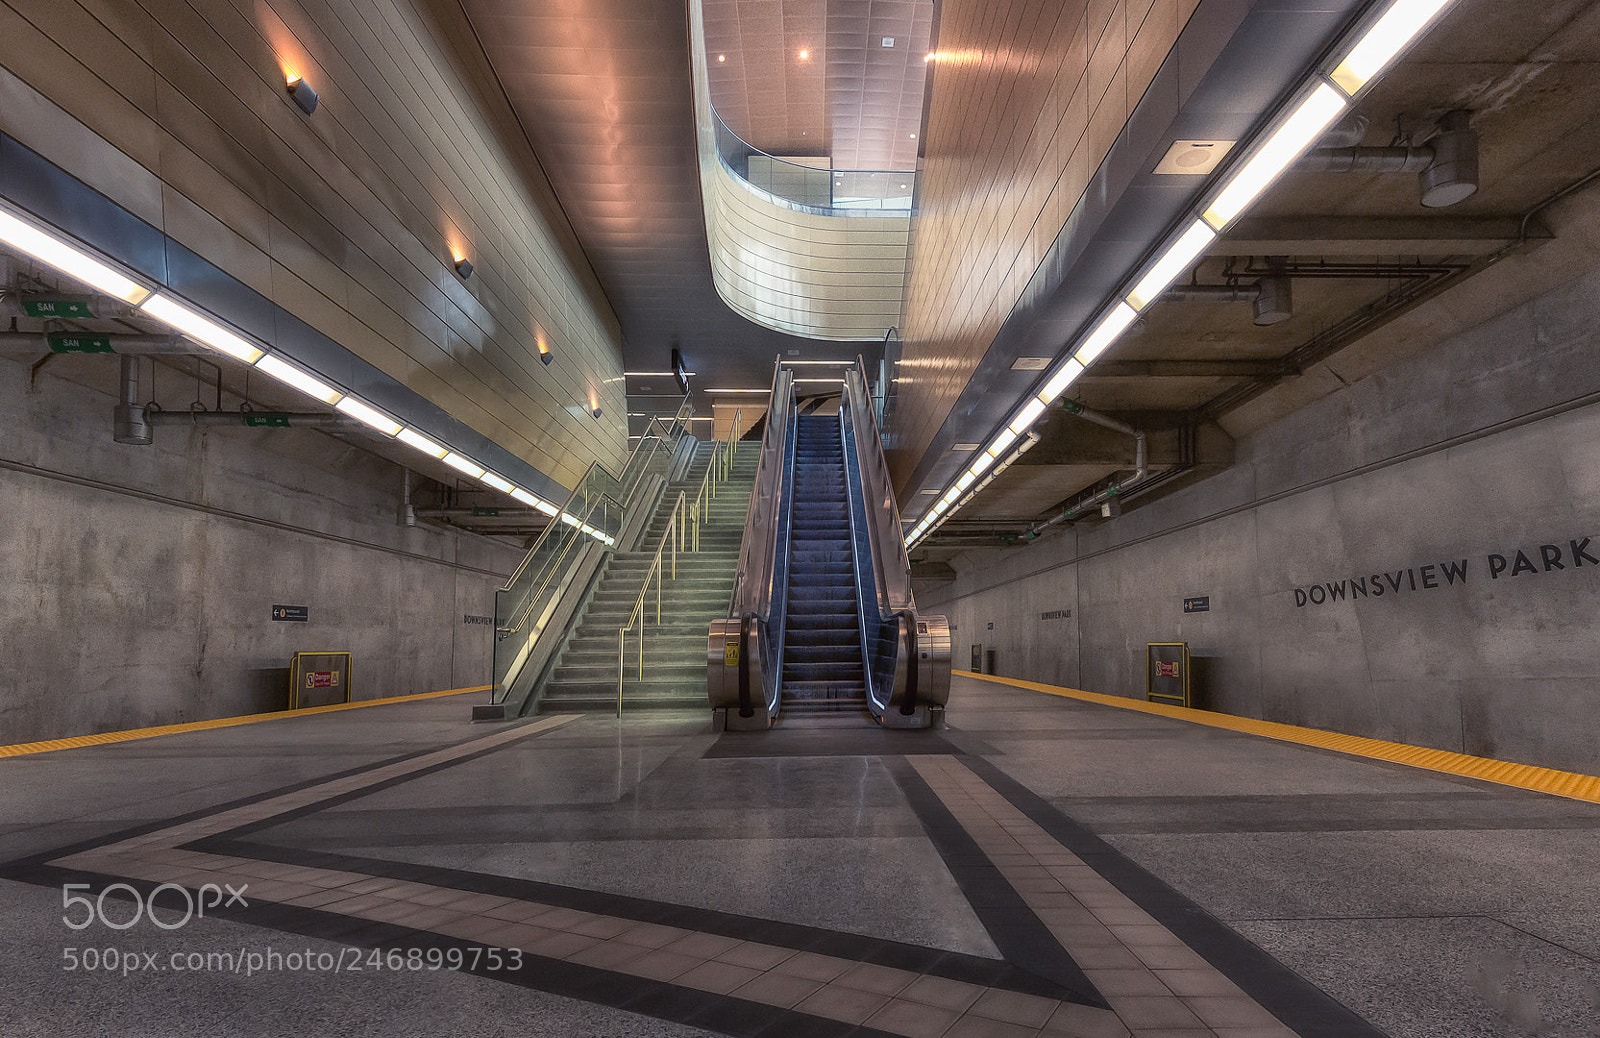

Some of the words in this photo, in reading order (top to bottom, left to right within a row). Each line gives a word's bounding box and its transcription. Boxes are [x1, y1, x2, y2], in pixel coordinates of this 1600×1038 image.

[37, 302, 55, 312] SAN
[62, 339, 80, 347] SAN
[1294, 558, 1468, 608] DOWNSVIEW
[1487, 536, 1600, 580] PARK
